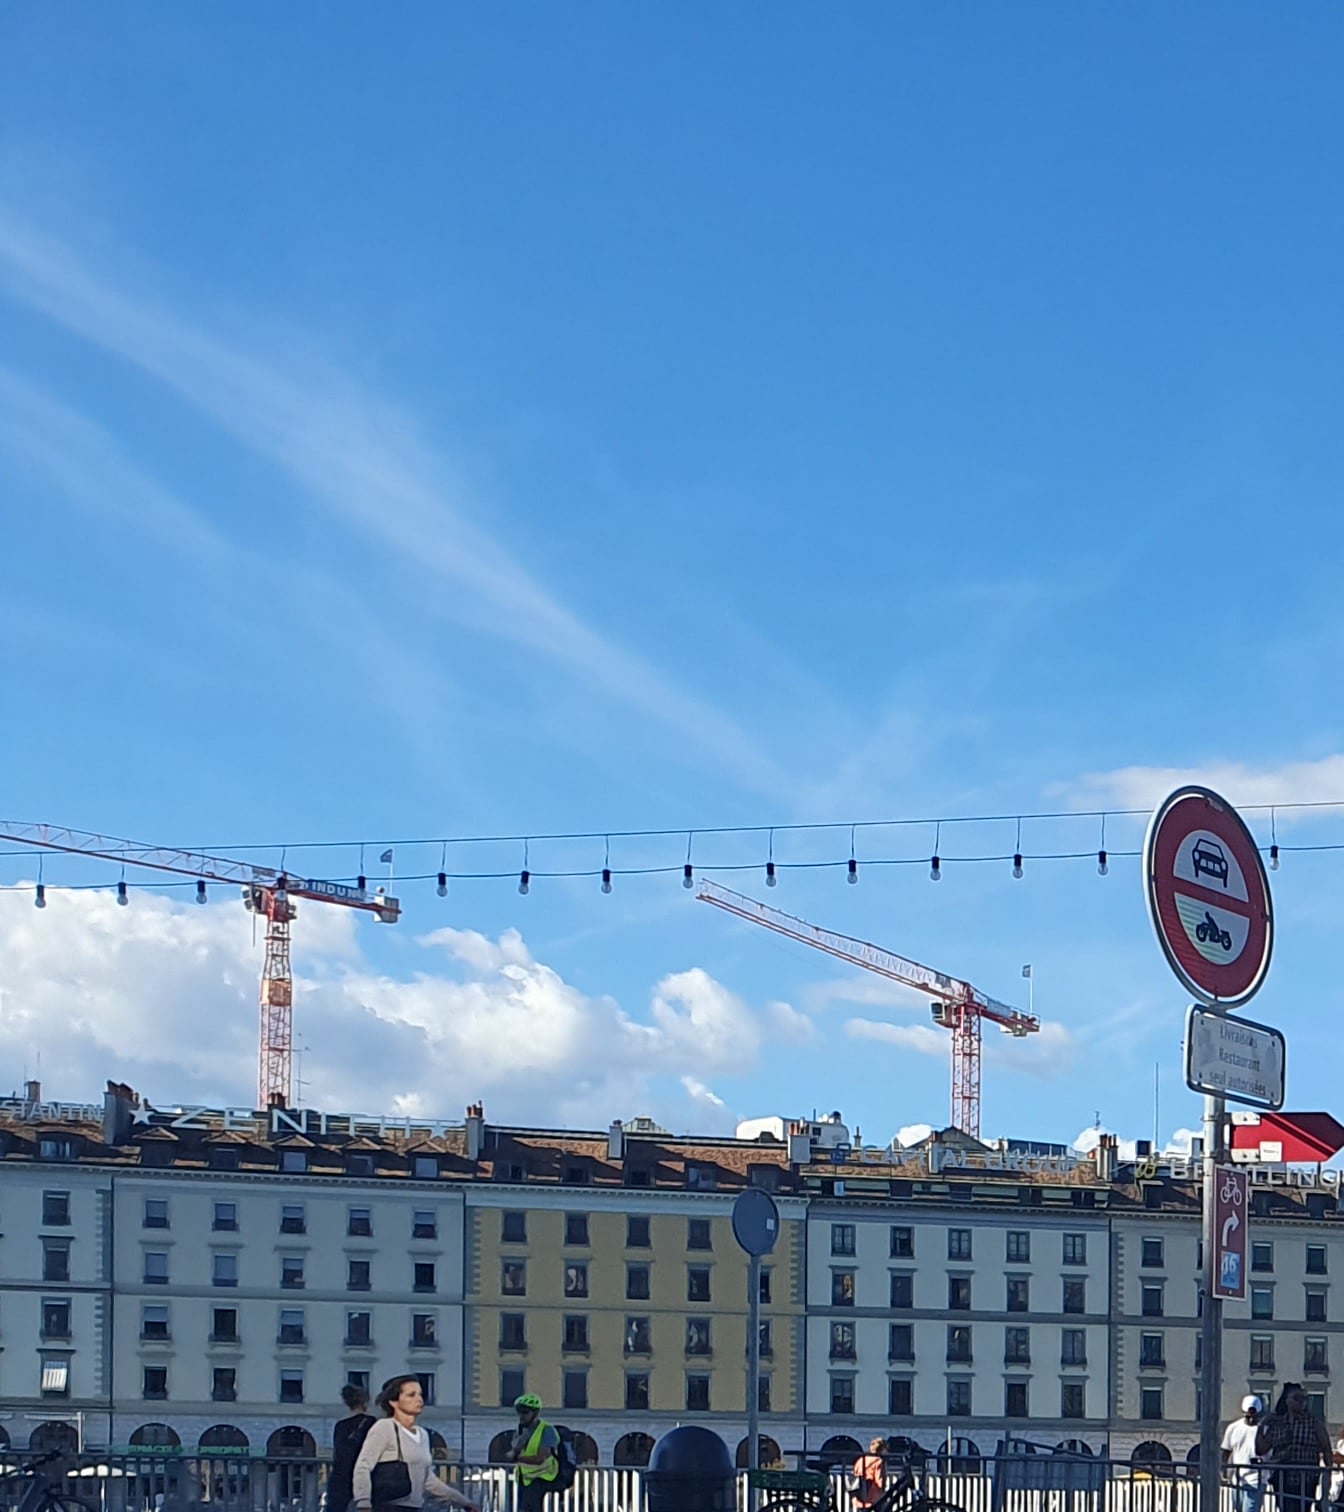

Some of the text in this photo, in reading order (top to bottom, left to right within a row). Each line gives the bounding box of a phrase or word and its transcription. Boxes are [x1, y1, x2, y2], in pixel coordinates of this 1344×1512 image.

[1218, 1047, 1261, 1073] Restaurant
[1209, 1070, 1226, 1086] seul
[170, 1104, 411, 1139] ZENITH
